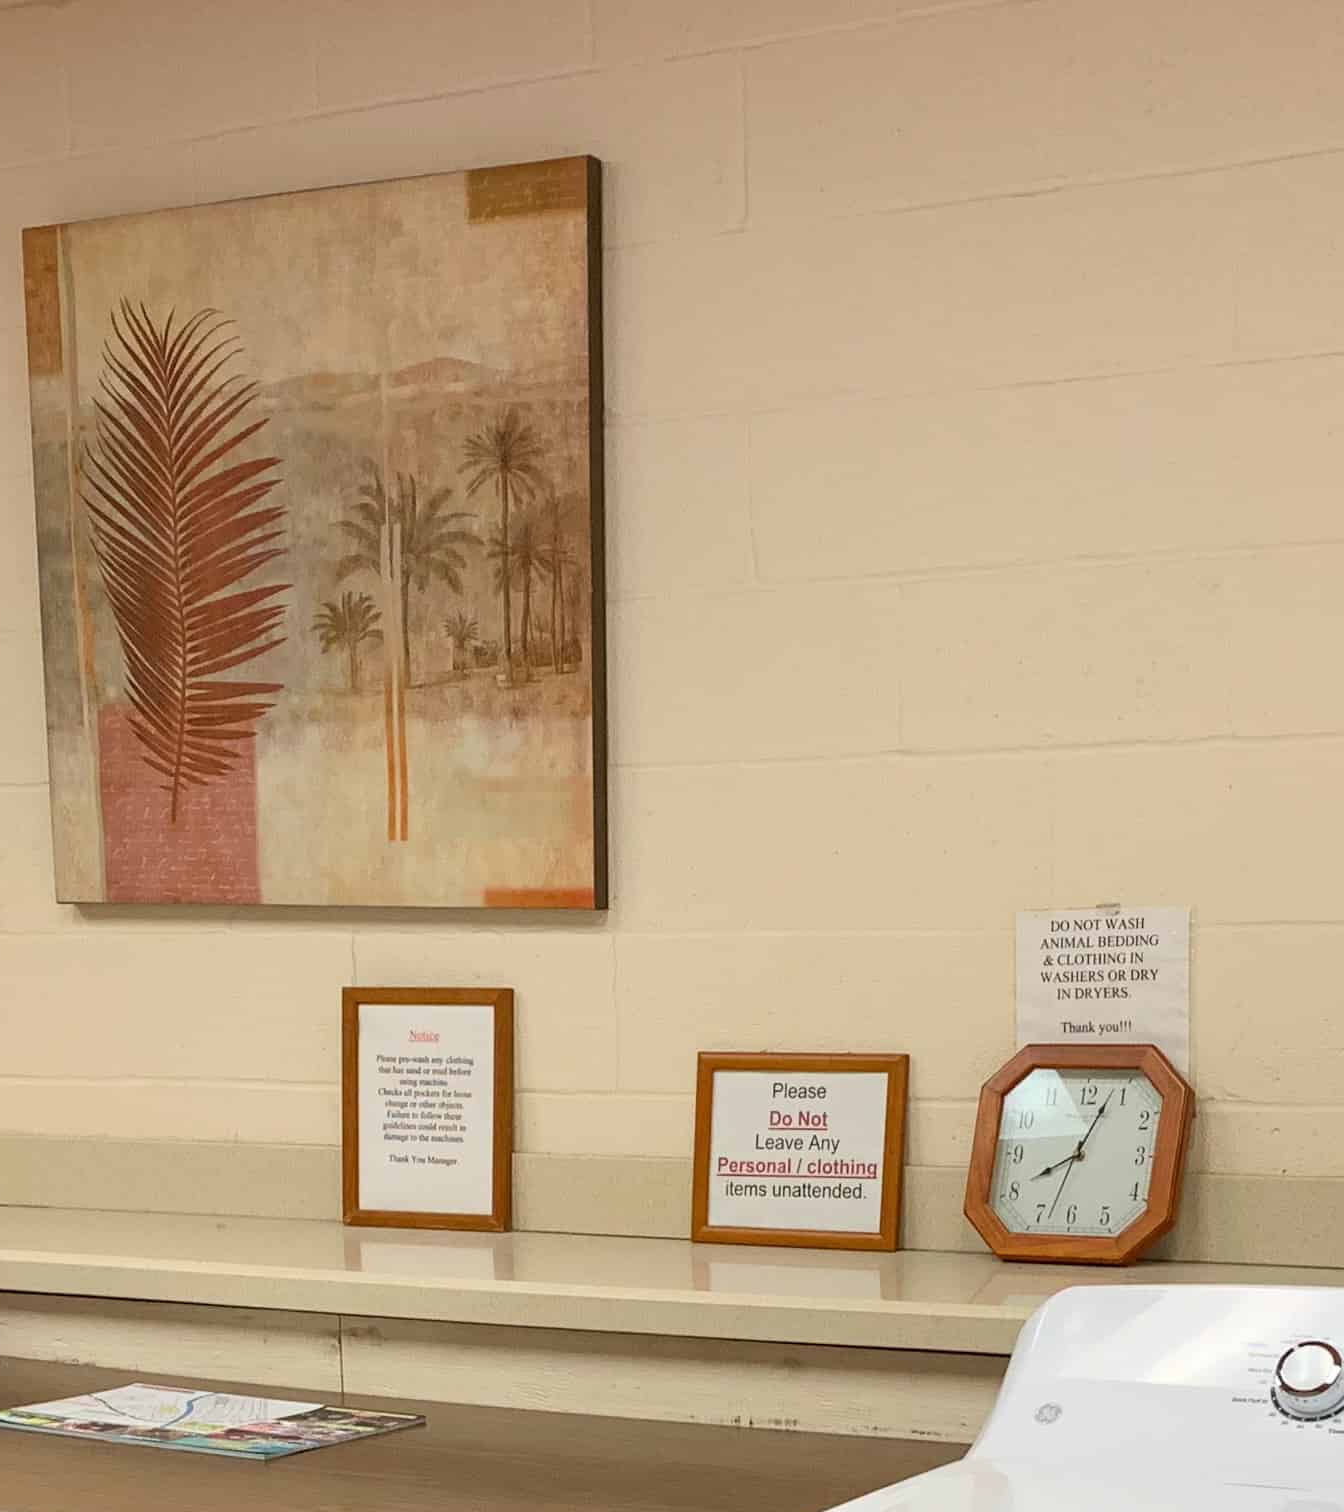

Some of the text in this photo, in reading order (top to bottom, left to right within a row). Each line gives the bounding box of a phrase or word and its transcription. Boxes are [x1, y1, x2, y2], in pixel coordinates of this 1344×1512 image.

[1051, 918, 1145, 932] DO NOT WASH
[1040, 935, 1159, 950] ANIMAL BEDDING
[1043, 952, 1144, 966] & CLOTHING IN
[1040, 969, 1159, 983] WASHERS OR DRY
[1057, 987, 1132, 1000] IN DRYERS.
[1061, 1021, 1132, 1036] Thank you!!!
[772, 1082, 827, 1099] Please
[1079, 1085, 1098, 1106] 12
[1119, 1088, 1127, 1106] 1
[769, 1111, 828, 1128] Do Not
[1018, 1110, 1034, 1129] 10
[1138, 1111, 1150, 1131] 2
[755, 1134, 840, 1154] Leave Any
[1012, 1145, 1024, 1164] 9
[1134, 1146, 1146, 1166] 3
[717, 1157, 878, 1178] Personal / clothing
[725, 1180, 867, 1200] items unattended.
[1009, 1182, 1021, 1201] 8
[1128, 1183, 1139, 1201] 4
[1036, 1204, 1046, 1223] 7
[1066, 1205, 1078, 1225] 6
[1099, 1206, 1111, 1225] 5
